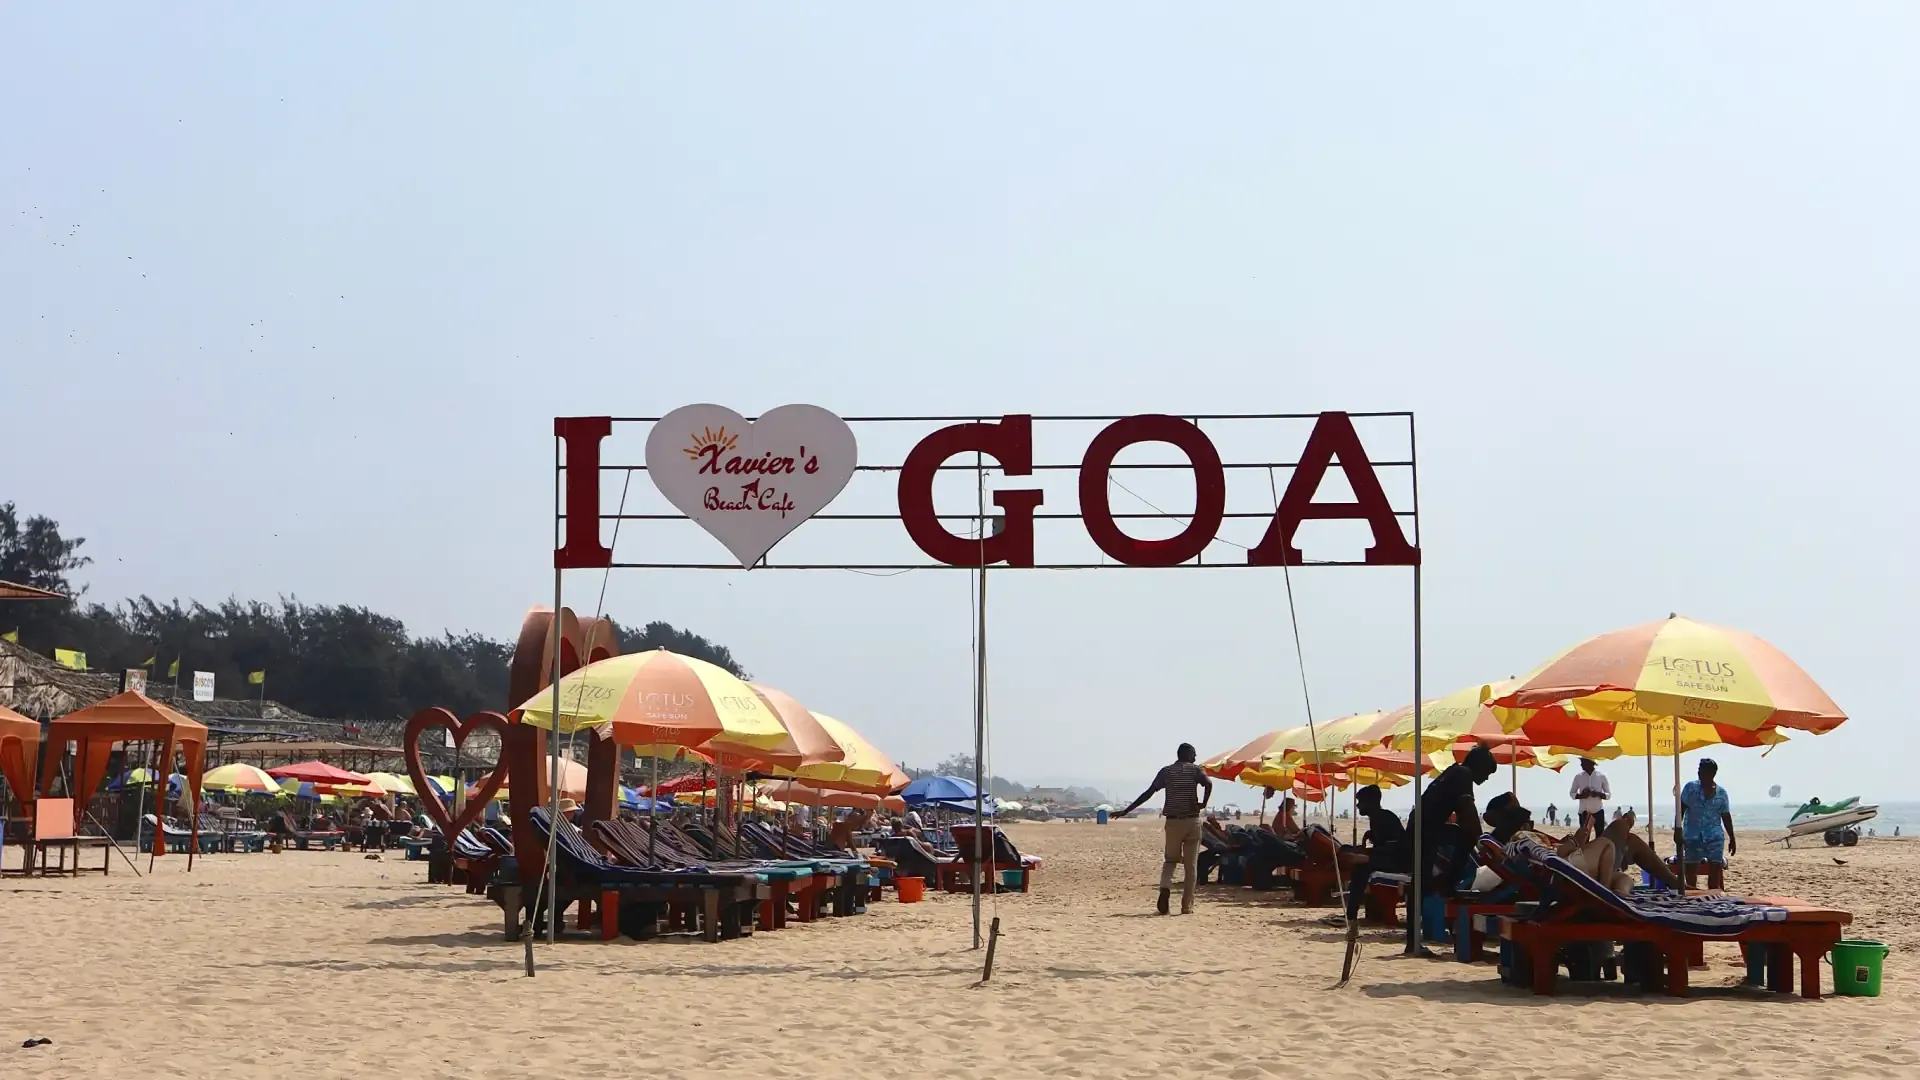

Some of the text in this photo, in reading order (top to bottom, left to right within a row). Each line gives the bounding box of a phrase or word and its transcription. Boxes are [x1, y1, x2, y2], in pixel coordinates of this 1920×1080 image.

[699, 444, 819, 475] Xavier's
[554, 411, 1421, 569] I GOA
[704, 485, 796, 519] Beach Cafe
[1662, 656, 1734, 677] LOTUS
[638, 691, 694, 706] LOTUS
[1676, 680, 1728, 693] SAFE SUN
